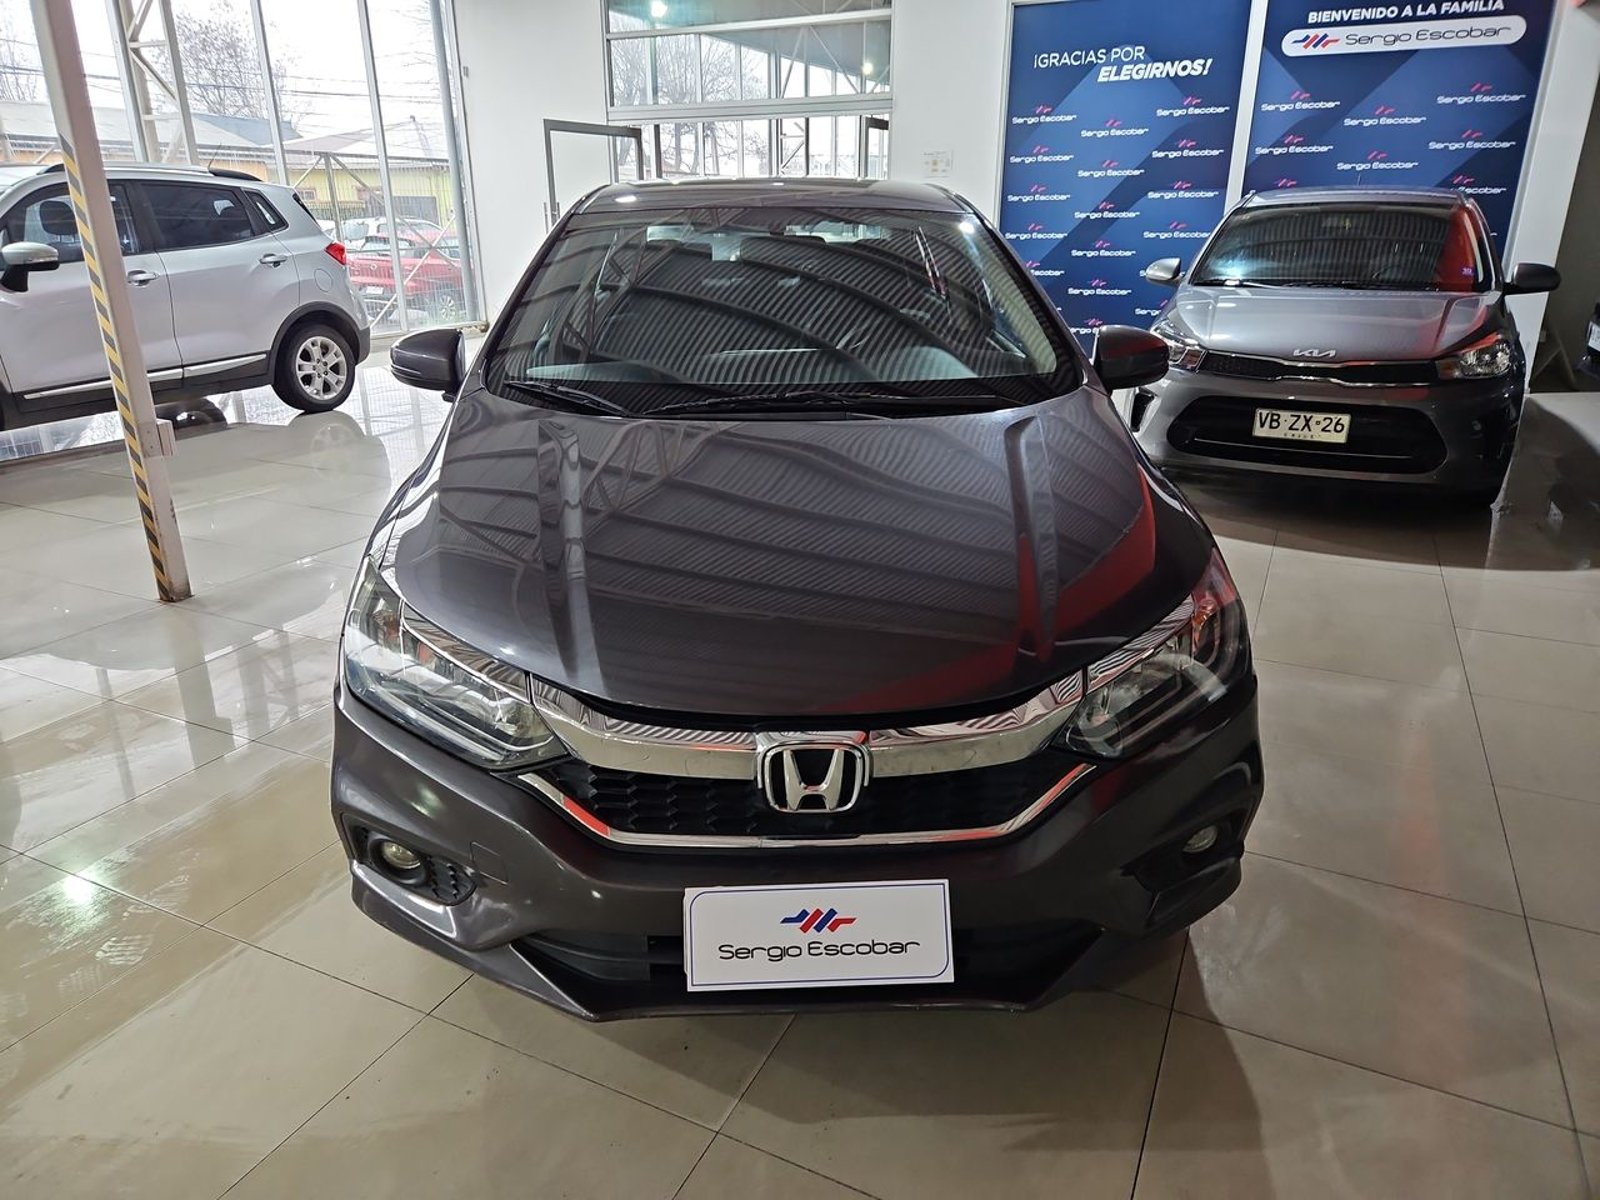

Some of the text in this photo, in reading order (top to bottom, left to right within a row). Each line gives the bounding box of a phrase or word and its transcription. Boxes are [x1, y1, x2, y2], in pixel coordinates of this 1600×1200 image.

[1308, 0, 1504, 24] BIENVENIDO A LA FAMILIA
[1345, 26, 1511, 45] Sergio Escobar
[1110, 46, 1146, 63] POR
[1097, 58, 1213, 83] ELEGIRNOS!
[718, 939, 920, 962] Sergio Escobar
